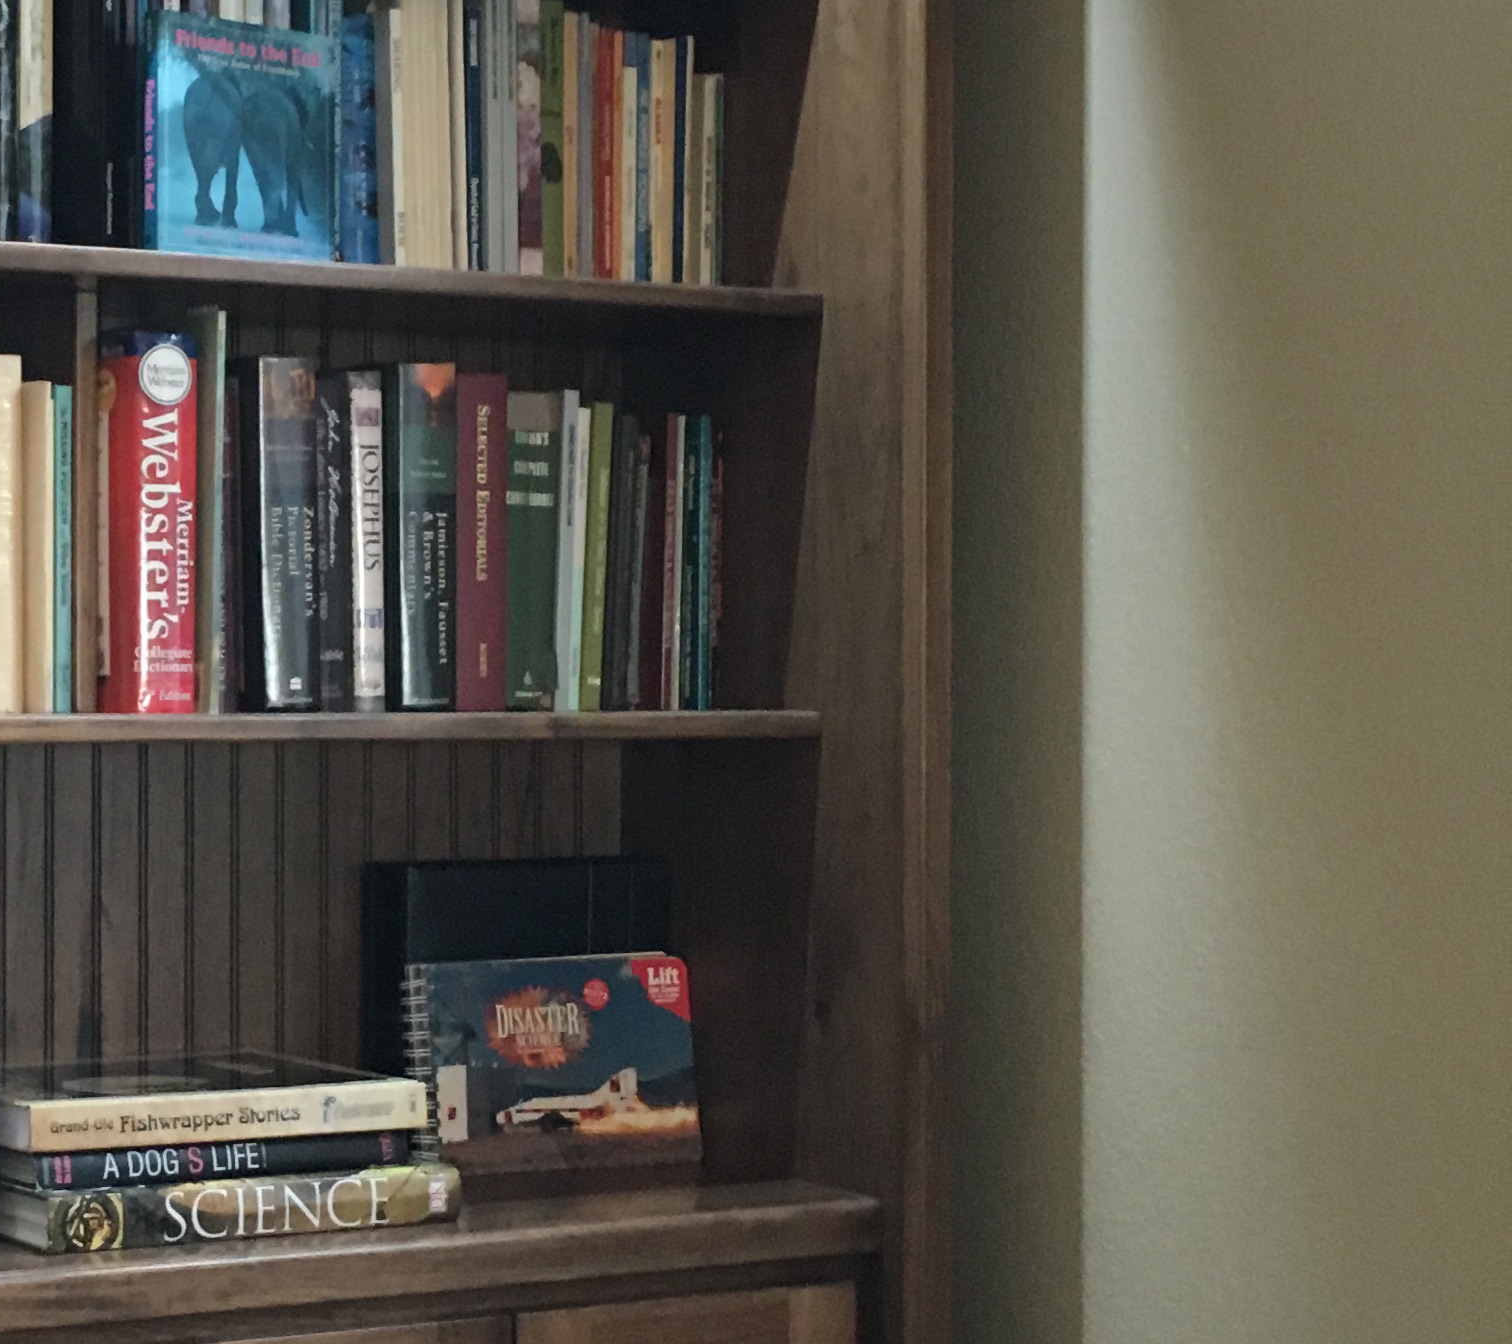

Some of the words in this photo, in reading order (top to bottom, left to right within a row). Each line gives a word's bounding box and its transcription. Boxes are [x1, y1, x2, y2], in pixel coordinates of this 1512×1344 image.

[261, 43, 288, 64] the
[320, 396, 341, 453] John
[476, 405, 491, 484] SELECTED
[140, 407, 182, 641] Webster's
[271, 506, 284, 546] Bible
[359, 444, 381, 571] JOSEPHUS
[422, 511, 434, 523] &
[476, 489, 491, 581] EDITORIALS
[175, 498, 194, 613] Merriam-
[286, 506, 300, 576] Pictorial
[302, 506, 317, 617] Zondervan's
[423, 530, 435, 600] Brown's
[435, 512, 449, 596] Jamieson,
[271, 553, 284, 639] Dictionary
[134, 645, 193, 660] Cllegiate
[438, 601, 450, 665] Fausset
[647, 966, 680, 986] Lift
[495, 1002, 581, 1039] DISASTER
[119, 1112, 234, 1136] Fishwrapper
[238, 1105, 302, 1126] Stories
[102, 1150, 121, 1180] A
[127, 1145, 205, 1179] DOG'S
[162, 1177, 390, 1243] SCIENCE
